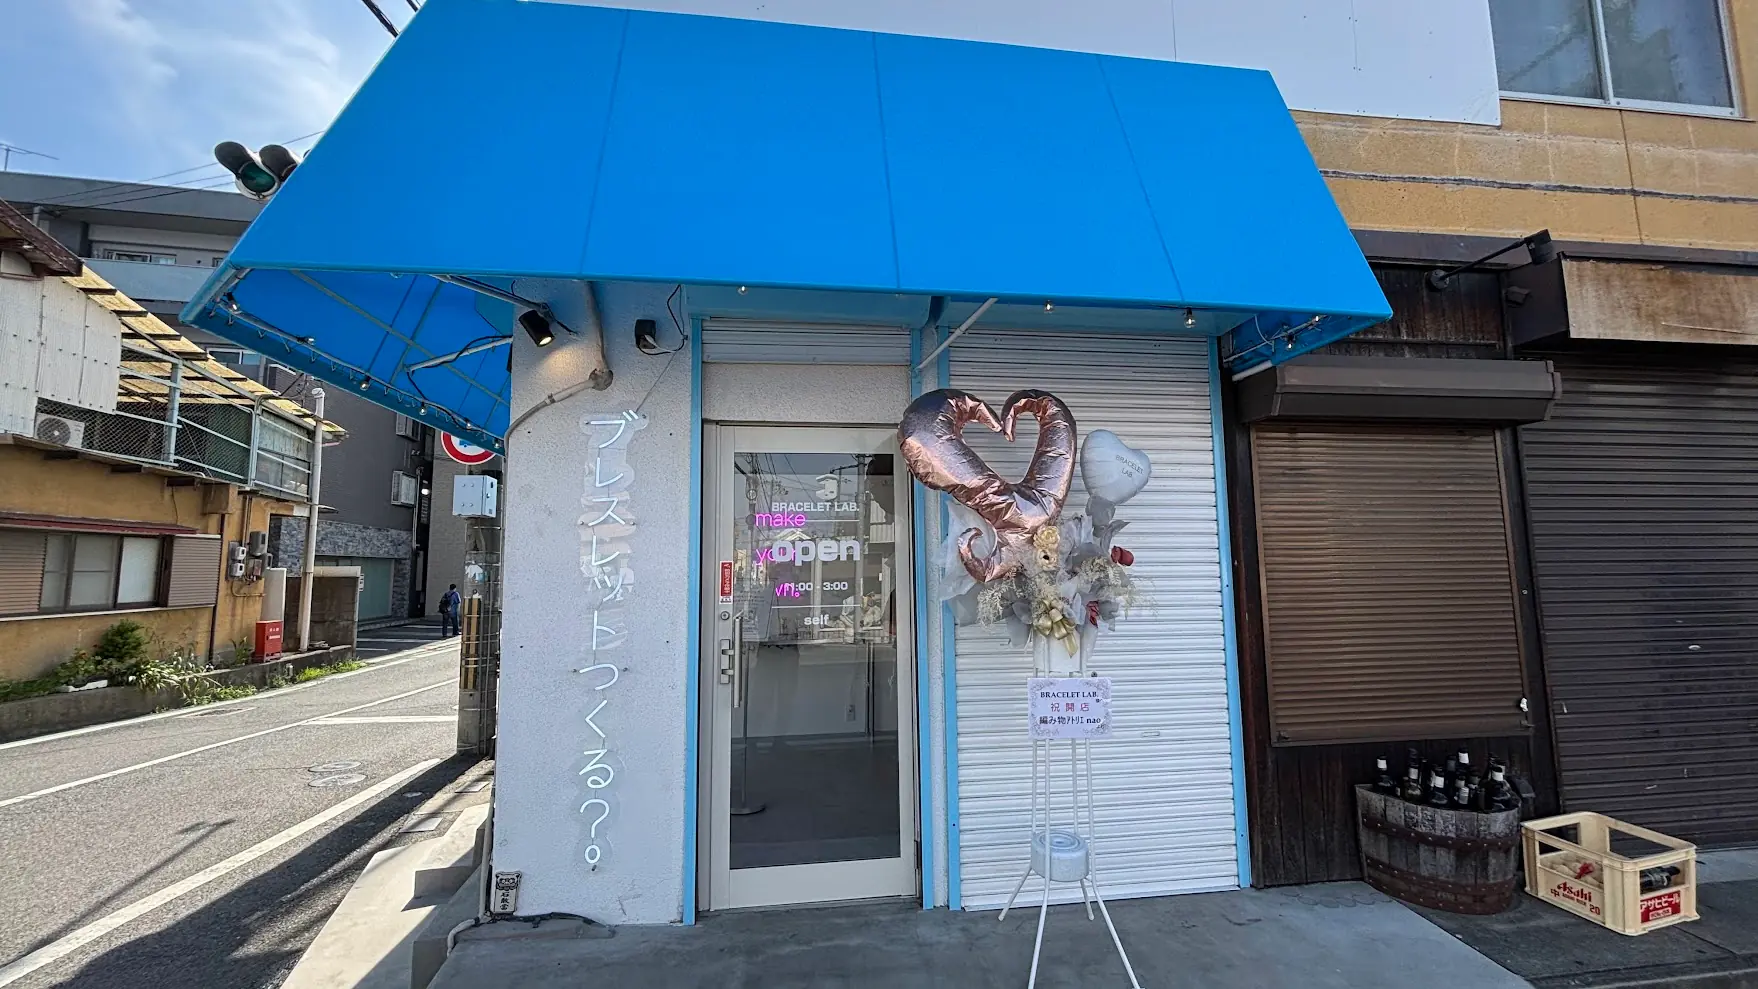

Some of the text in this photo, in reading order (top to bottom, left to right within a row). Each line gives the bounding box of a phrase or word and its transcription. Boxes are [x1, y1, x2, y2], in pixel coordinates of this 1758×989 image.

[1115, 454, 1144, 474] BRACELET
[772, 502, 860, 512] BRACELET LAB.
[755, 511, 806, 527] make
[771, 539, 861, 567] open
[823, 582, 848, 591] 3:00
[804, 614, 829, 625] self
[1557, 881, 1592, 902] Asahi
[1589, 904, 1601, 915] 20
[1640, 893, 1680, 912] アサヒビール
